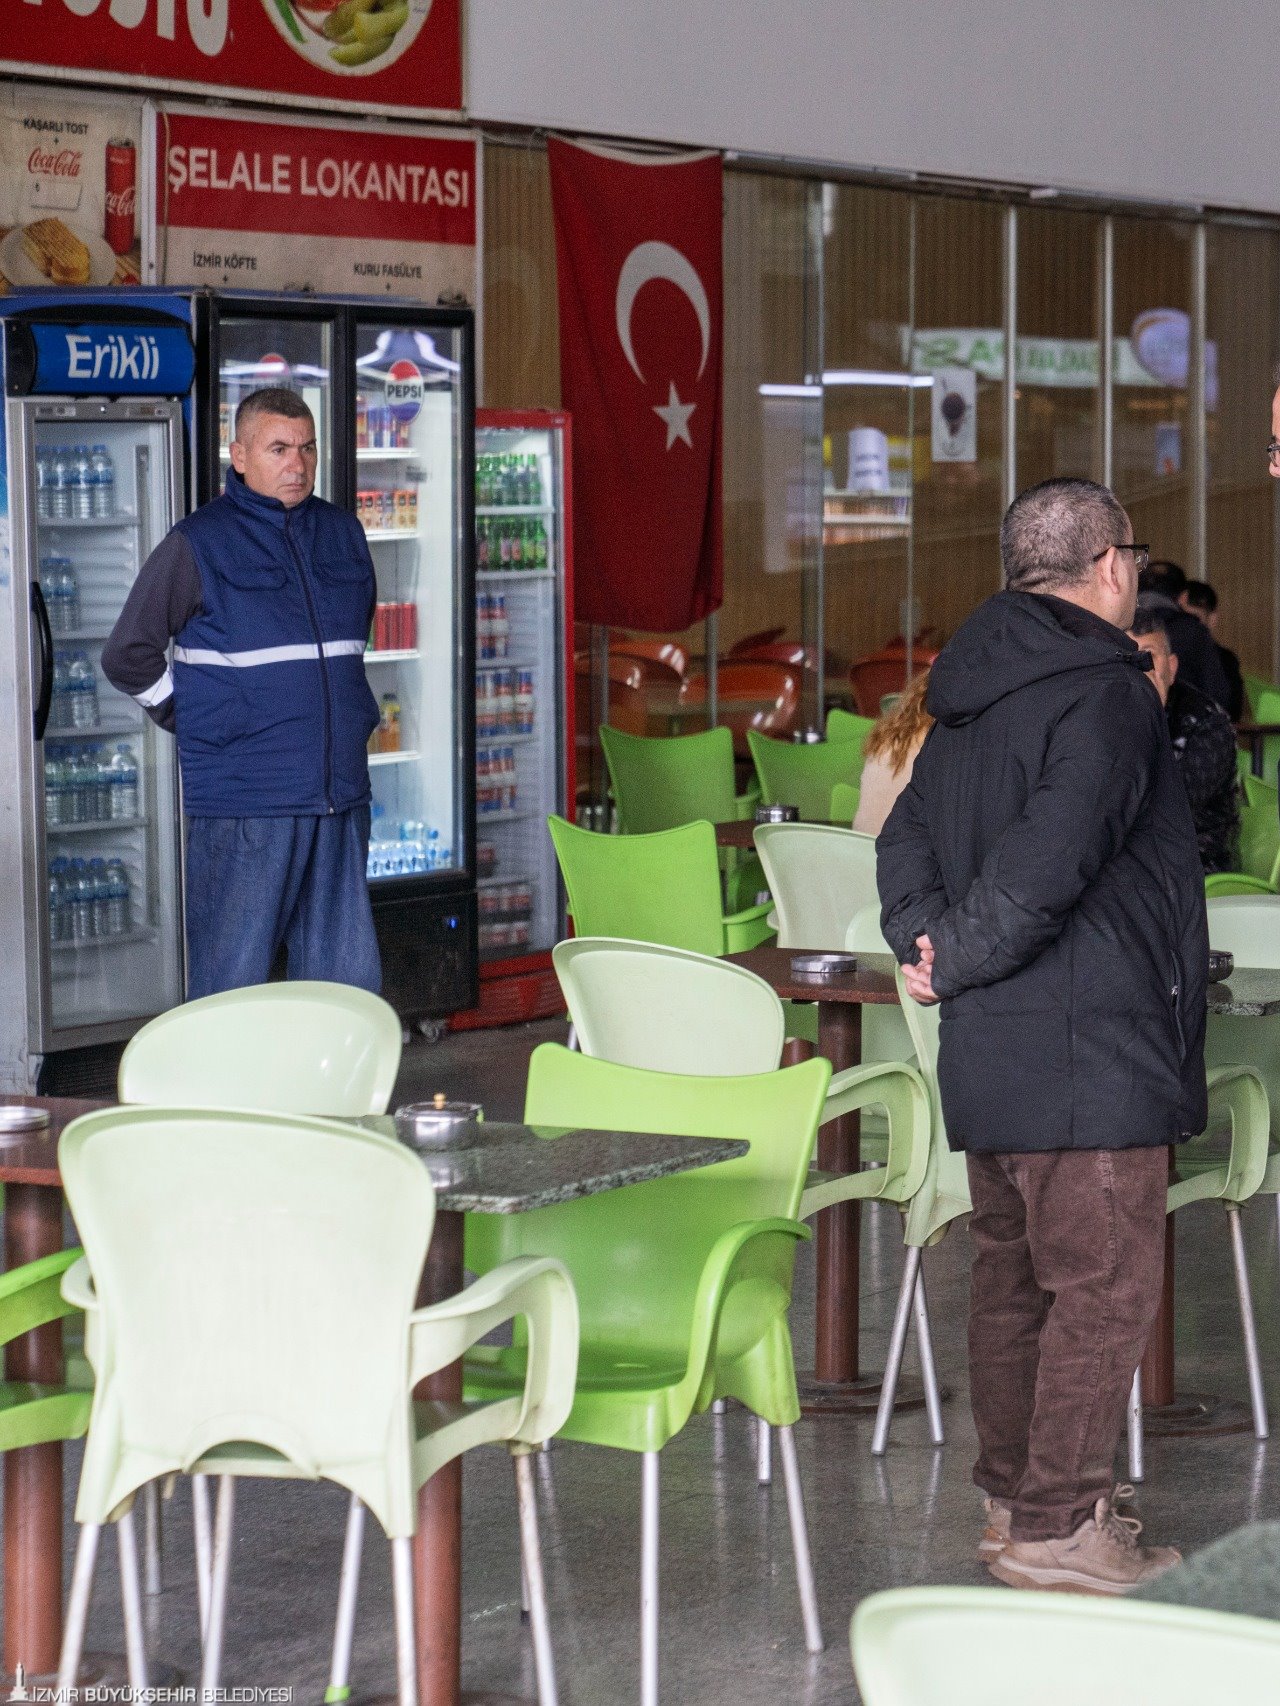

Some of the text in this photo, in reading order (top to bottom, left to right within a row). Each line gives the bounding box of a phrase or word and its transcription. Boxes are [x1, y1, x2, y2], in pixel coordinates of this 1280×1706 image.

[66, 121, 88, 135] TOST
[168, 145, 469, 208] ŞELALE LOKANTASI
[193, 251, 257, 271] İZMİR KÖFTE
[353, 262, 380, 277] KURU
[66, 334, 159, 380] Erikli
[387, 380, 421, 399] PEPSI
